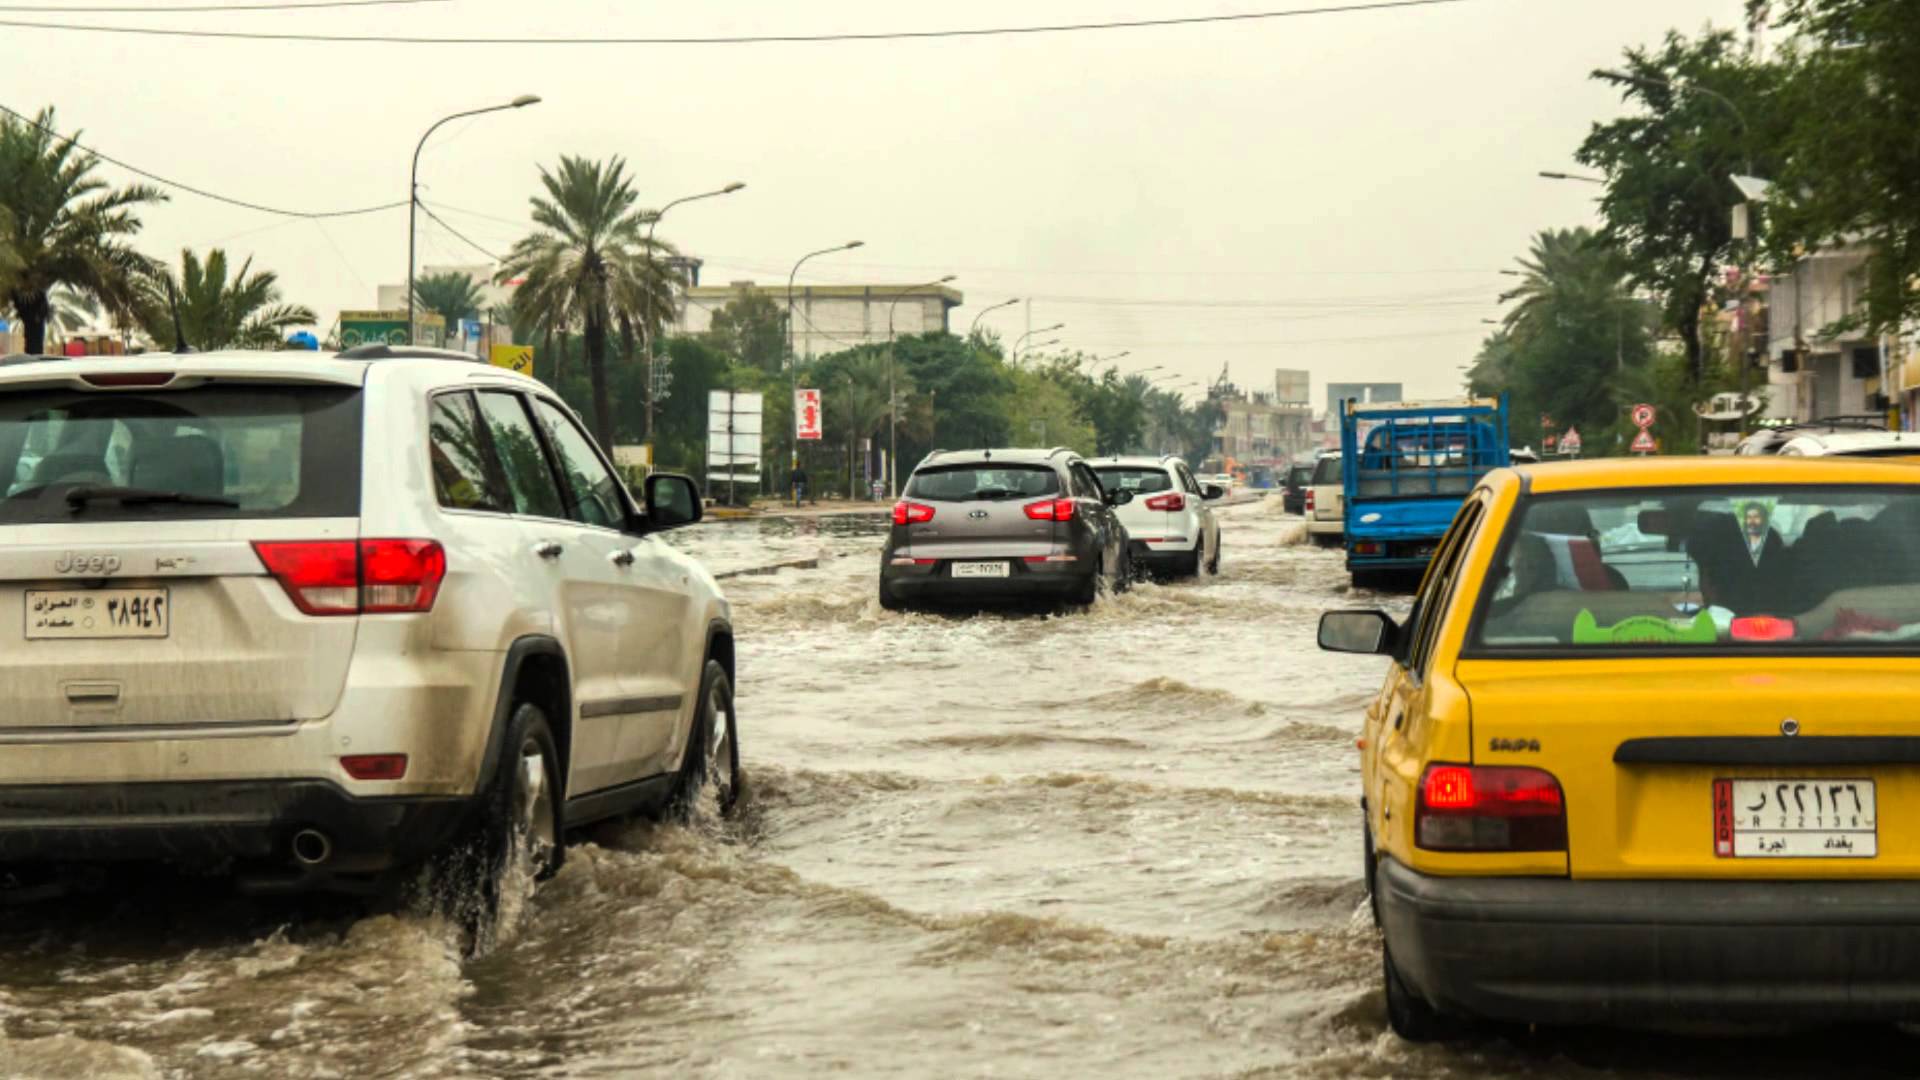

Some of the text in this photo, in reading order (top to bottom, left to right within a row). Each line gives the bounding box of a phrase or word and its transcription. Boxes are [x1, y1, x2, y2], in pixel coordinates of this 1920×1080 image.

[55, 551, 122, 576] Jeep
[107, 595, 164, 628] ٣٨٩٤٢
[1489, 737, 1541, 752] SAIPA
[1775, 783, 1862, 814] ٢٢١٣٦
